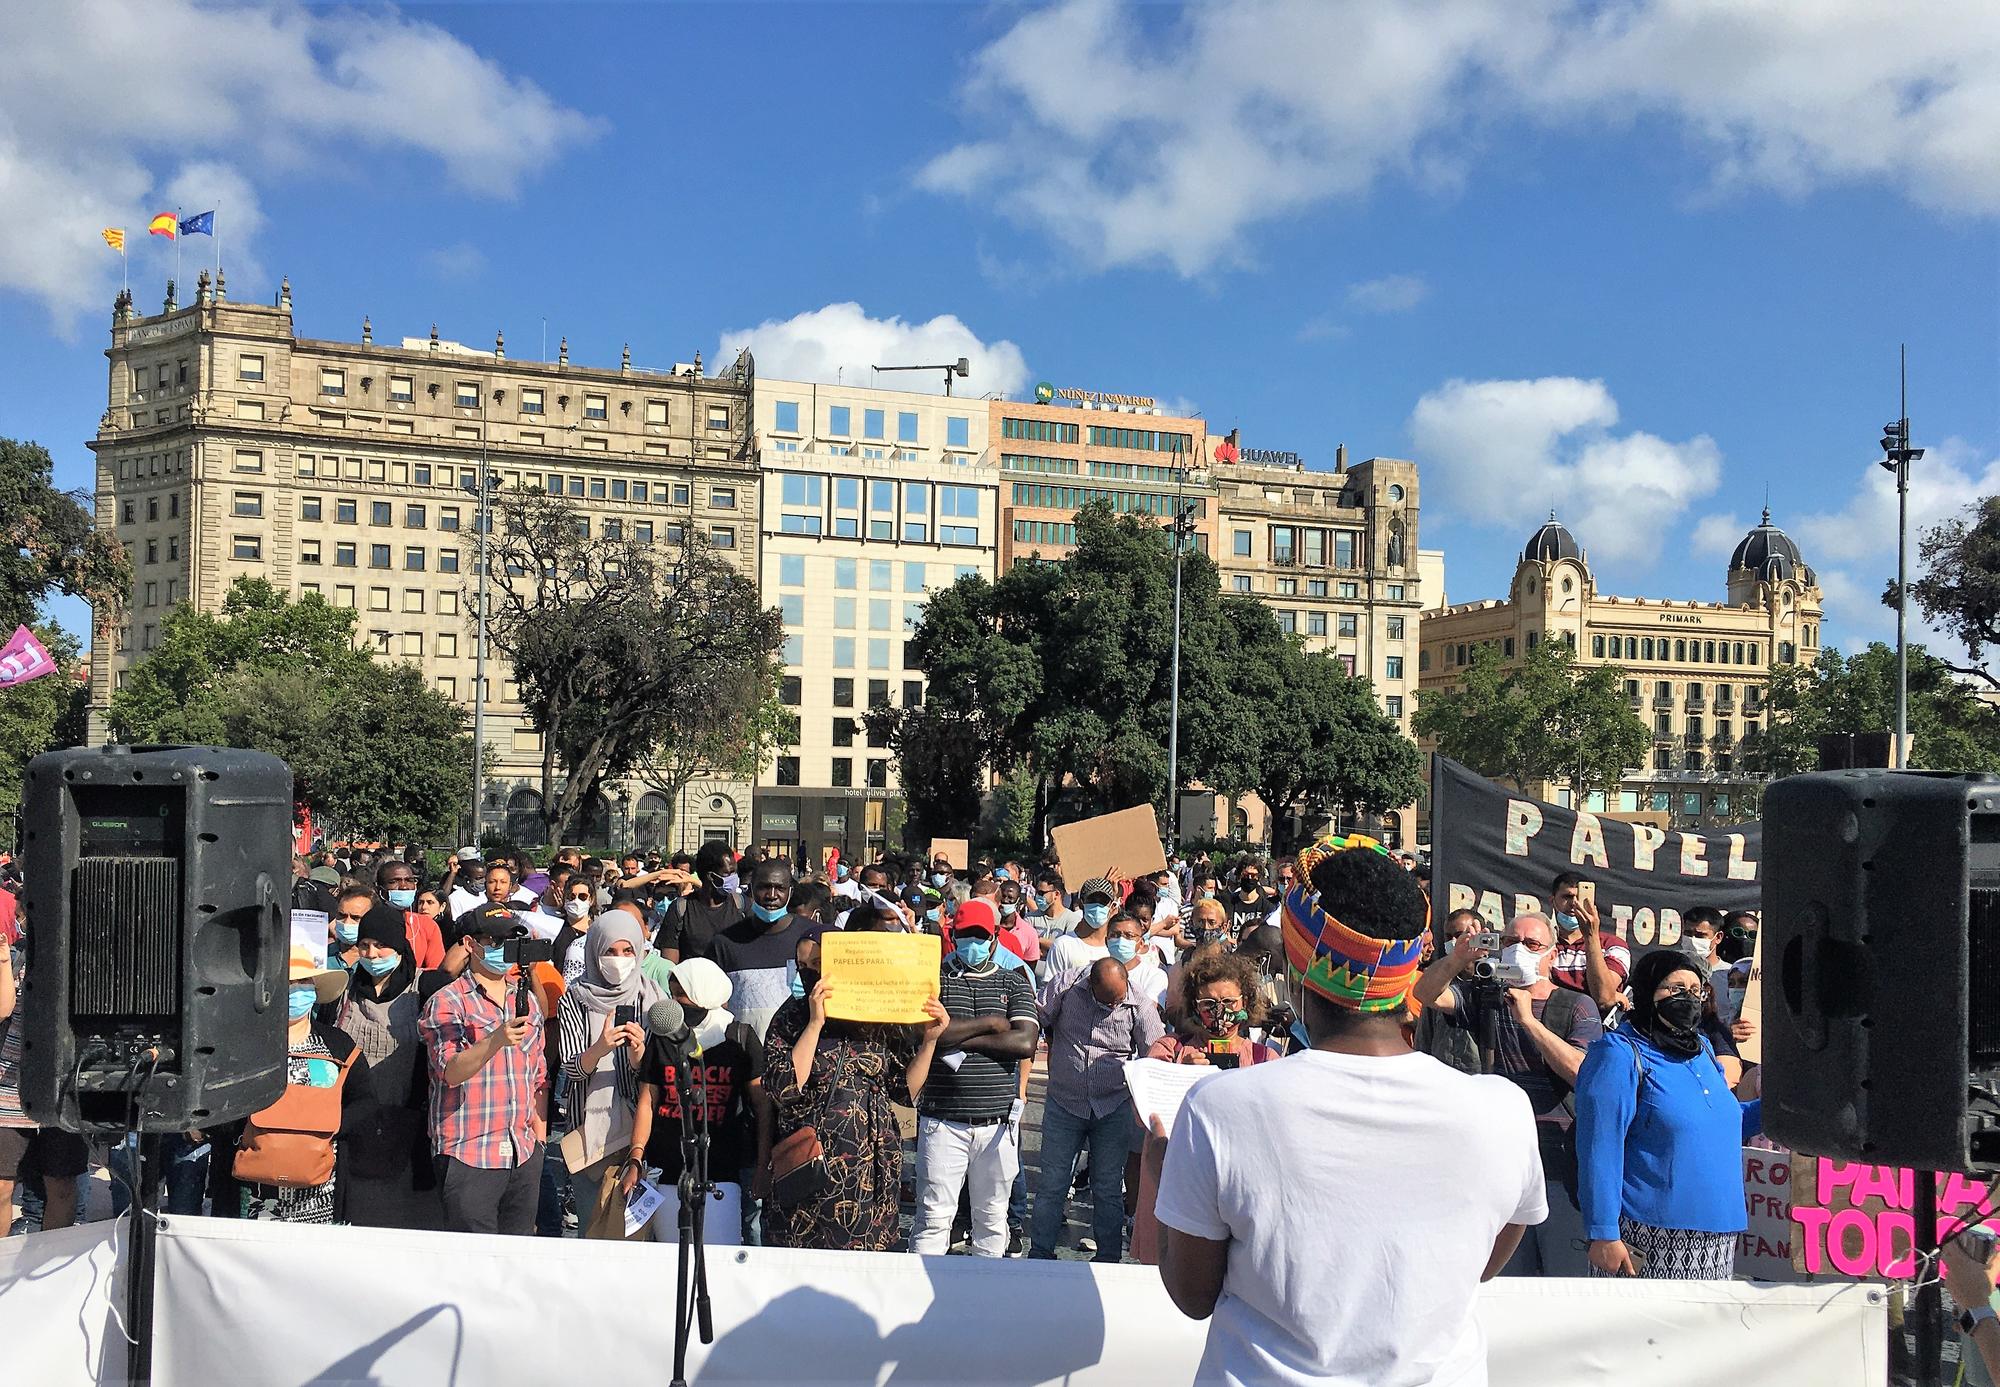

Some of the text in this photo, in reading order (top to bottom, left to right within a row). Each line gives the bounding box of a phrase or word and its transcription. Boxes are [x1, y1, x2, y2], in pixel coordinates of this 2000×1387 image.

[1056, 387, 1095, 401] NÚÑEZ
[1103, 392, 1155, 407] NAVARRO
[1240, 448, 1299, 465] HUAWEI
[1659, 613, 1703, 624] PRIMARK
[844, 788, 863, 796] hotel
[664, 1065, 732, 1083] BACK
